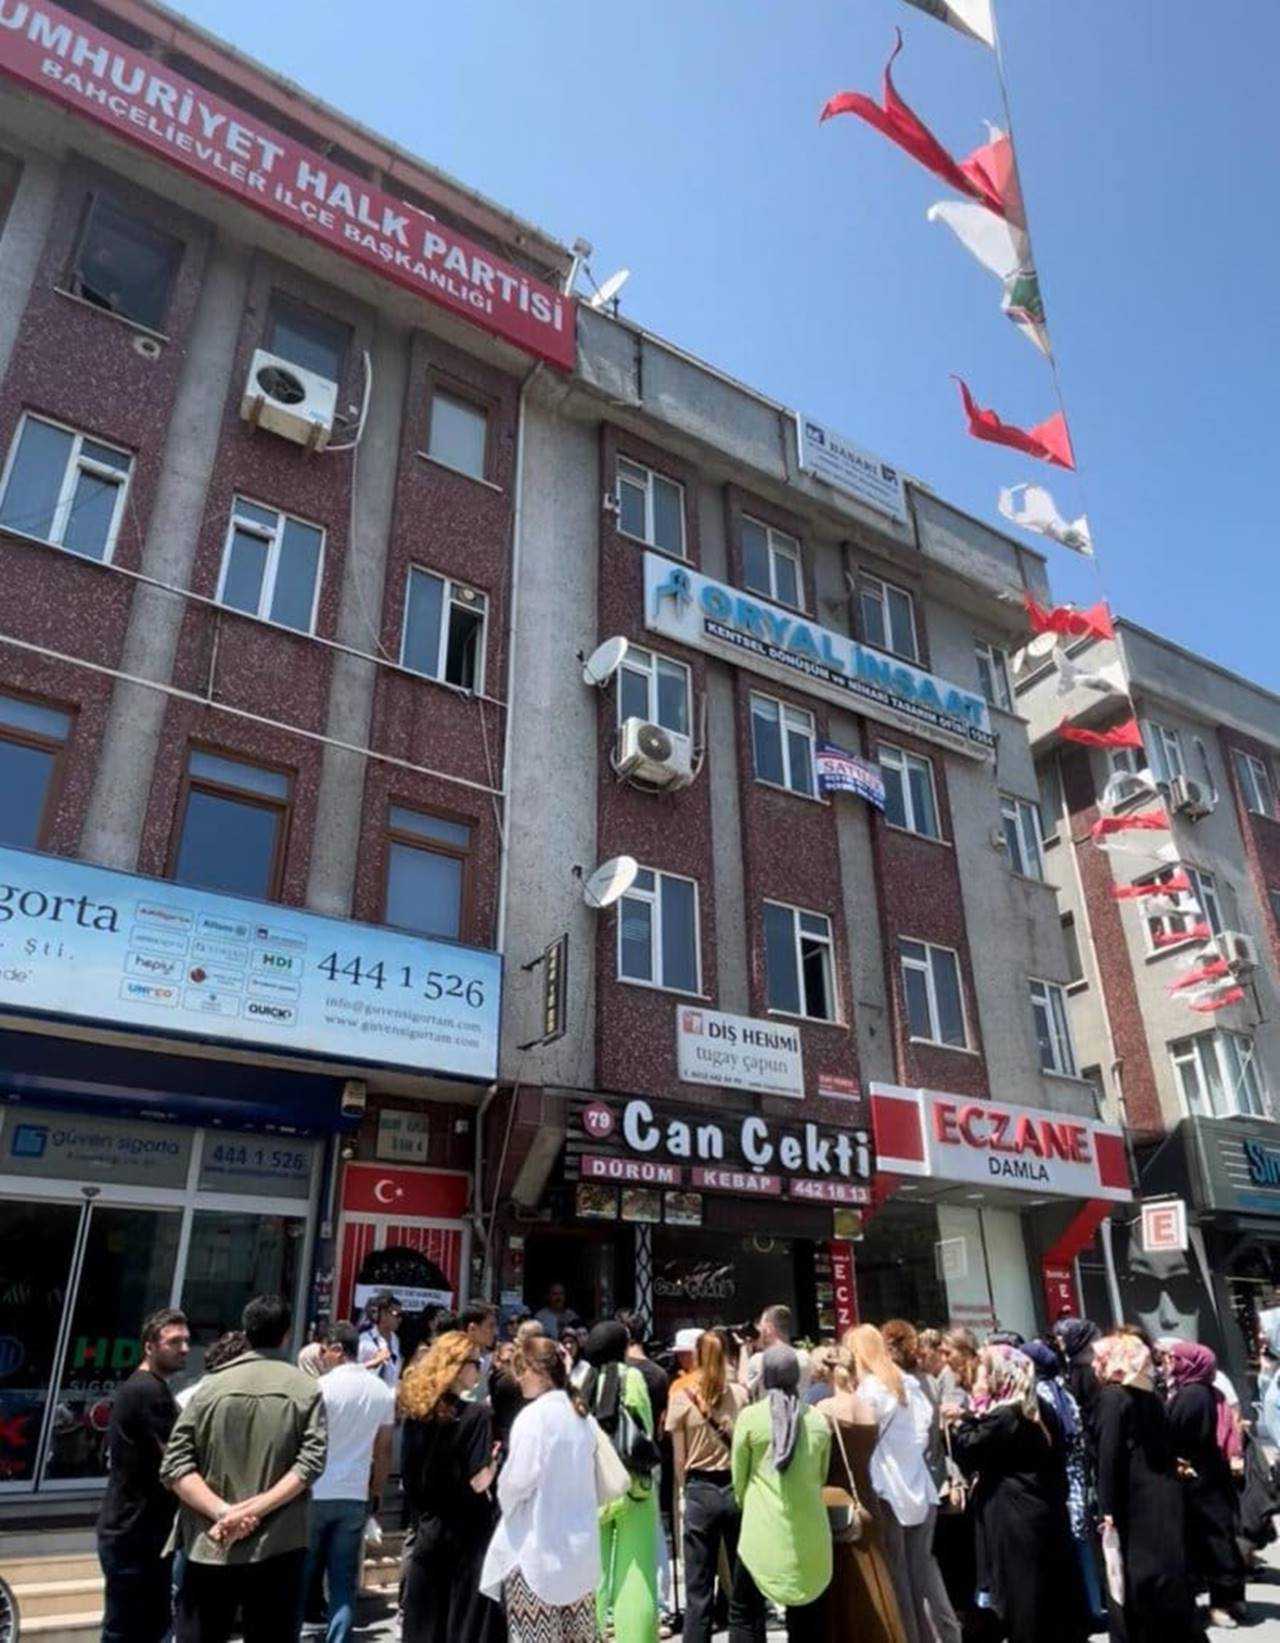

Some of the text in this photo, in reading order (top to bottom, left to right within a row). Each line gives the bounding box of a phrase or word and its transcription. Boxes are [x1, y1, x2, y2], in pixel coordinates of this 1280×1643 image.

[296, 160, 410, 248] HALK
[423, 230, 564, 332] PARTİSİ
[262, 953, 293, 970] HDI
[317, 952, 485, 1008] 444 1 526
[708, 1020, 738, 1046] DİŞ
[623, 1099, 870, 1178] Can Çekti
[932, 1101, 1093, 1164] ECZANE
[593, 1159, 675, 1184] DÜRÜM
[703, 1169, 771, 1191] KEBAP
[987, 1157, 1050, 1182] DAMLA
[1153, 1213, 1175, 1243] E
